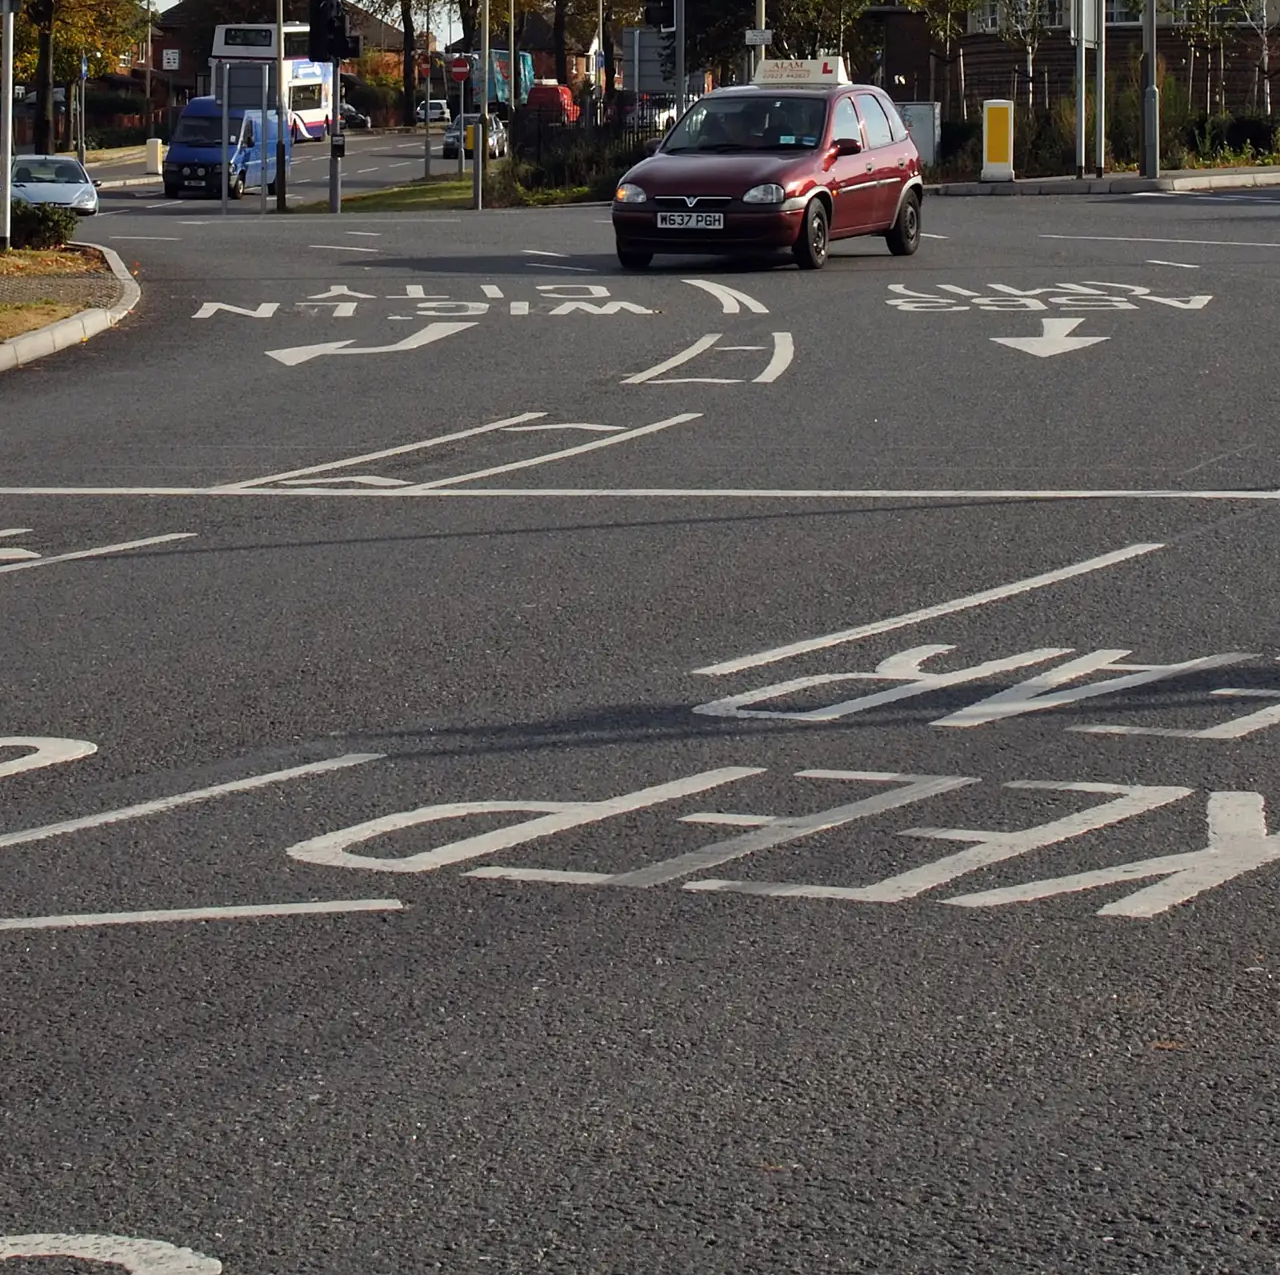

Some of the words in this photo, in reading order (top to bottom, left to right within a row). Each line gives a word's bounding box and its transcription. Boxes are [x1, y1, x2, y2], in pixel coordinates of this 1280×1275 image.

[821, 61, 834, 74] L
[660, 214, 693, 227] W637
[696, 214, 722, 227] PGH
[307, 284, 612, 298] CITY
[885, 295, 1213, 312] A563
